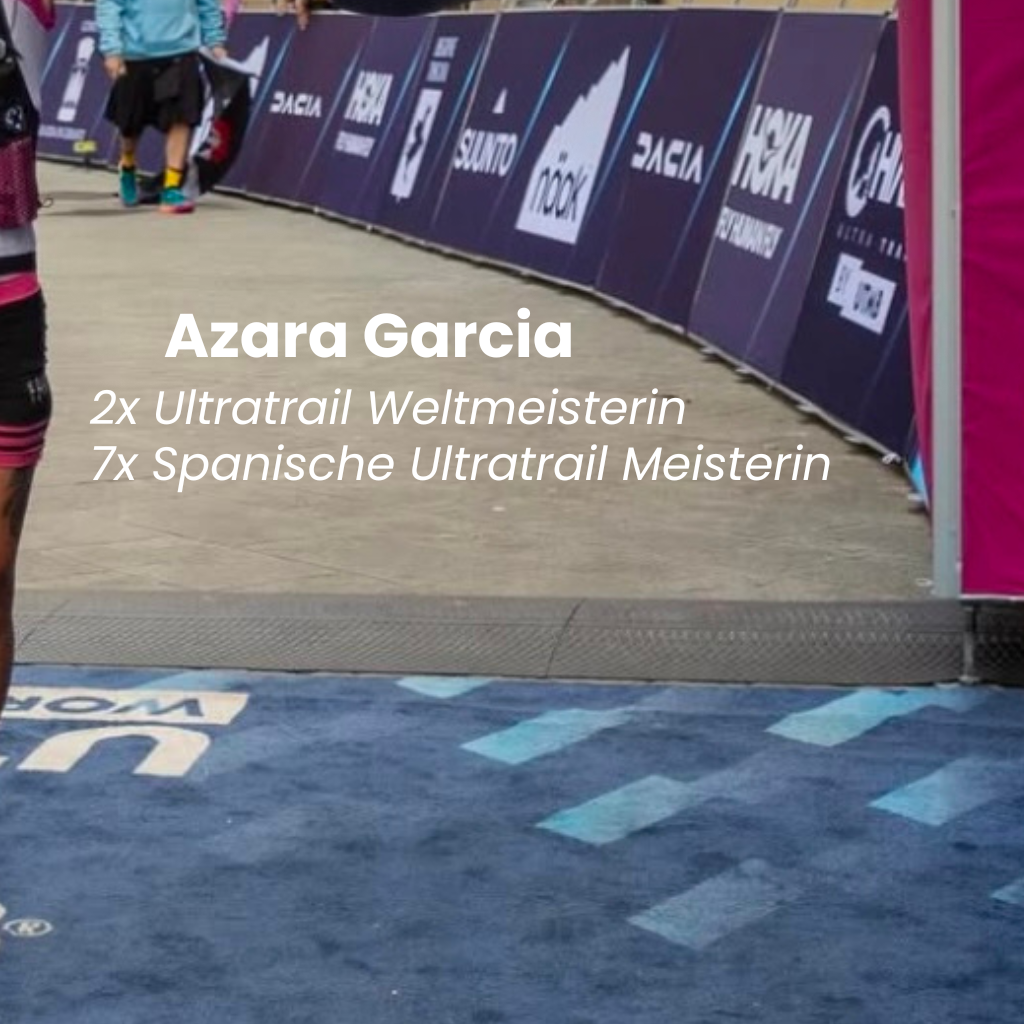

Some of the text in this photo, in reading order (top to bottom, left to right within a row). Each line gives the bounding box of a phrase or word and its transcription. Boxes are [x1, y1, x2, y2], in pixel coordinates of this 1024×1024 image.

[269, 90, 322, 119] DACIA
[454, 127, 518, 178] SUUNTO
[630, 131, 705, 185] DACIA
[729, 103, 814, 205] HOKA
